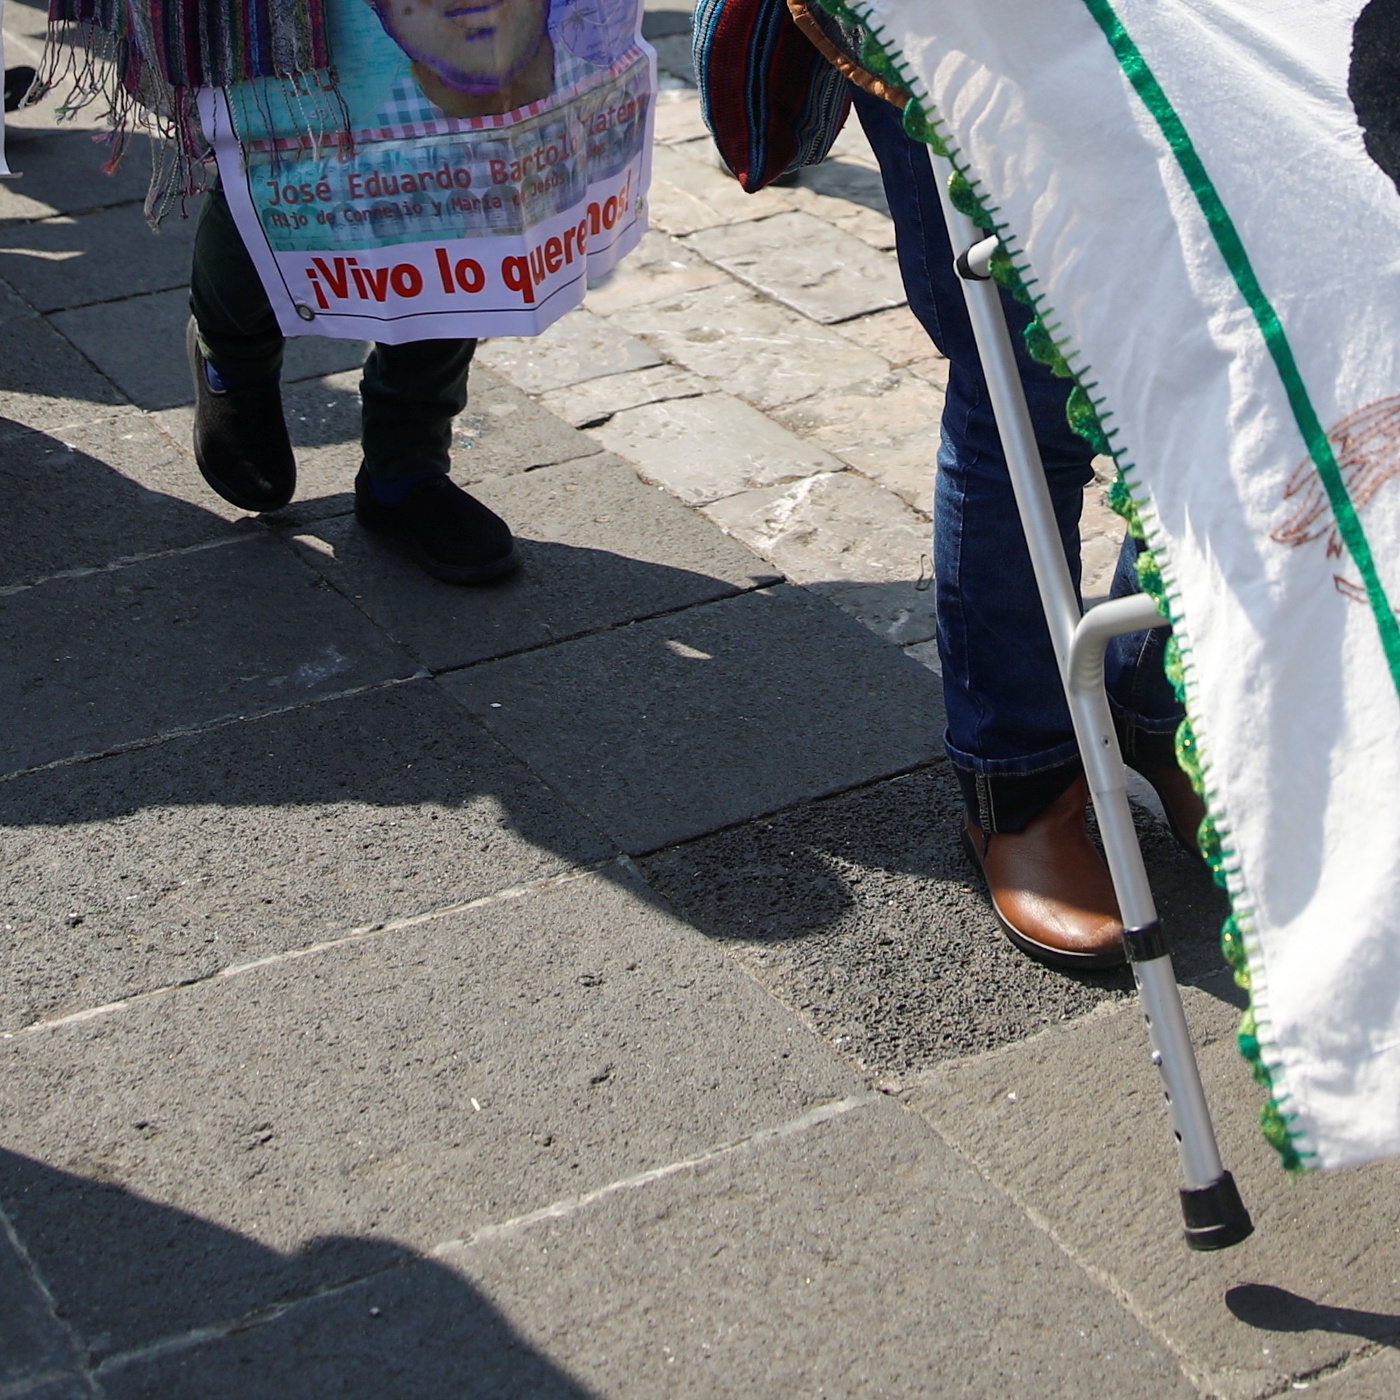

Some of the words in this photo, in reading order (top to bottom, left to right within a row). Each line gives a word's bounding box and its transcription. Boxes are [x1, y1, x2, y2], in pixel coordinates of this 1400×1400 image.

[266, 174, 332, 205] José
[348, 163, 471, 200] Eduardo
[489, 132, 582, 184] Bartolo
[271, 211, 308, 230] Hijo
[316, 210, 336, 225] de
[344, 200, 423, 223] Cornelio
[431, 201, 442, 216] y
[305, 256, 423, 310] ¡Vivo
[435, 248, 486, 294] lo
